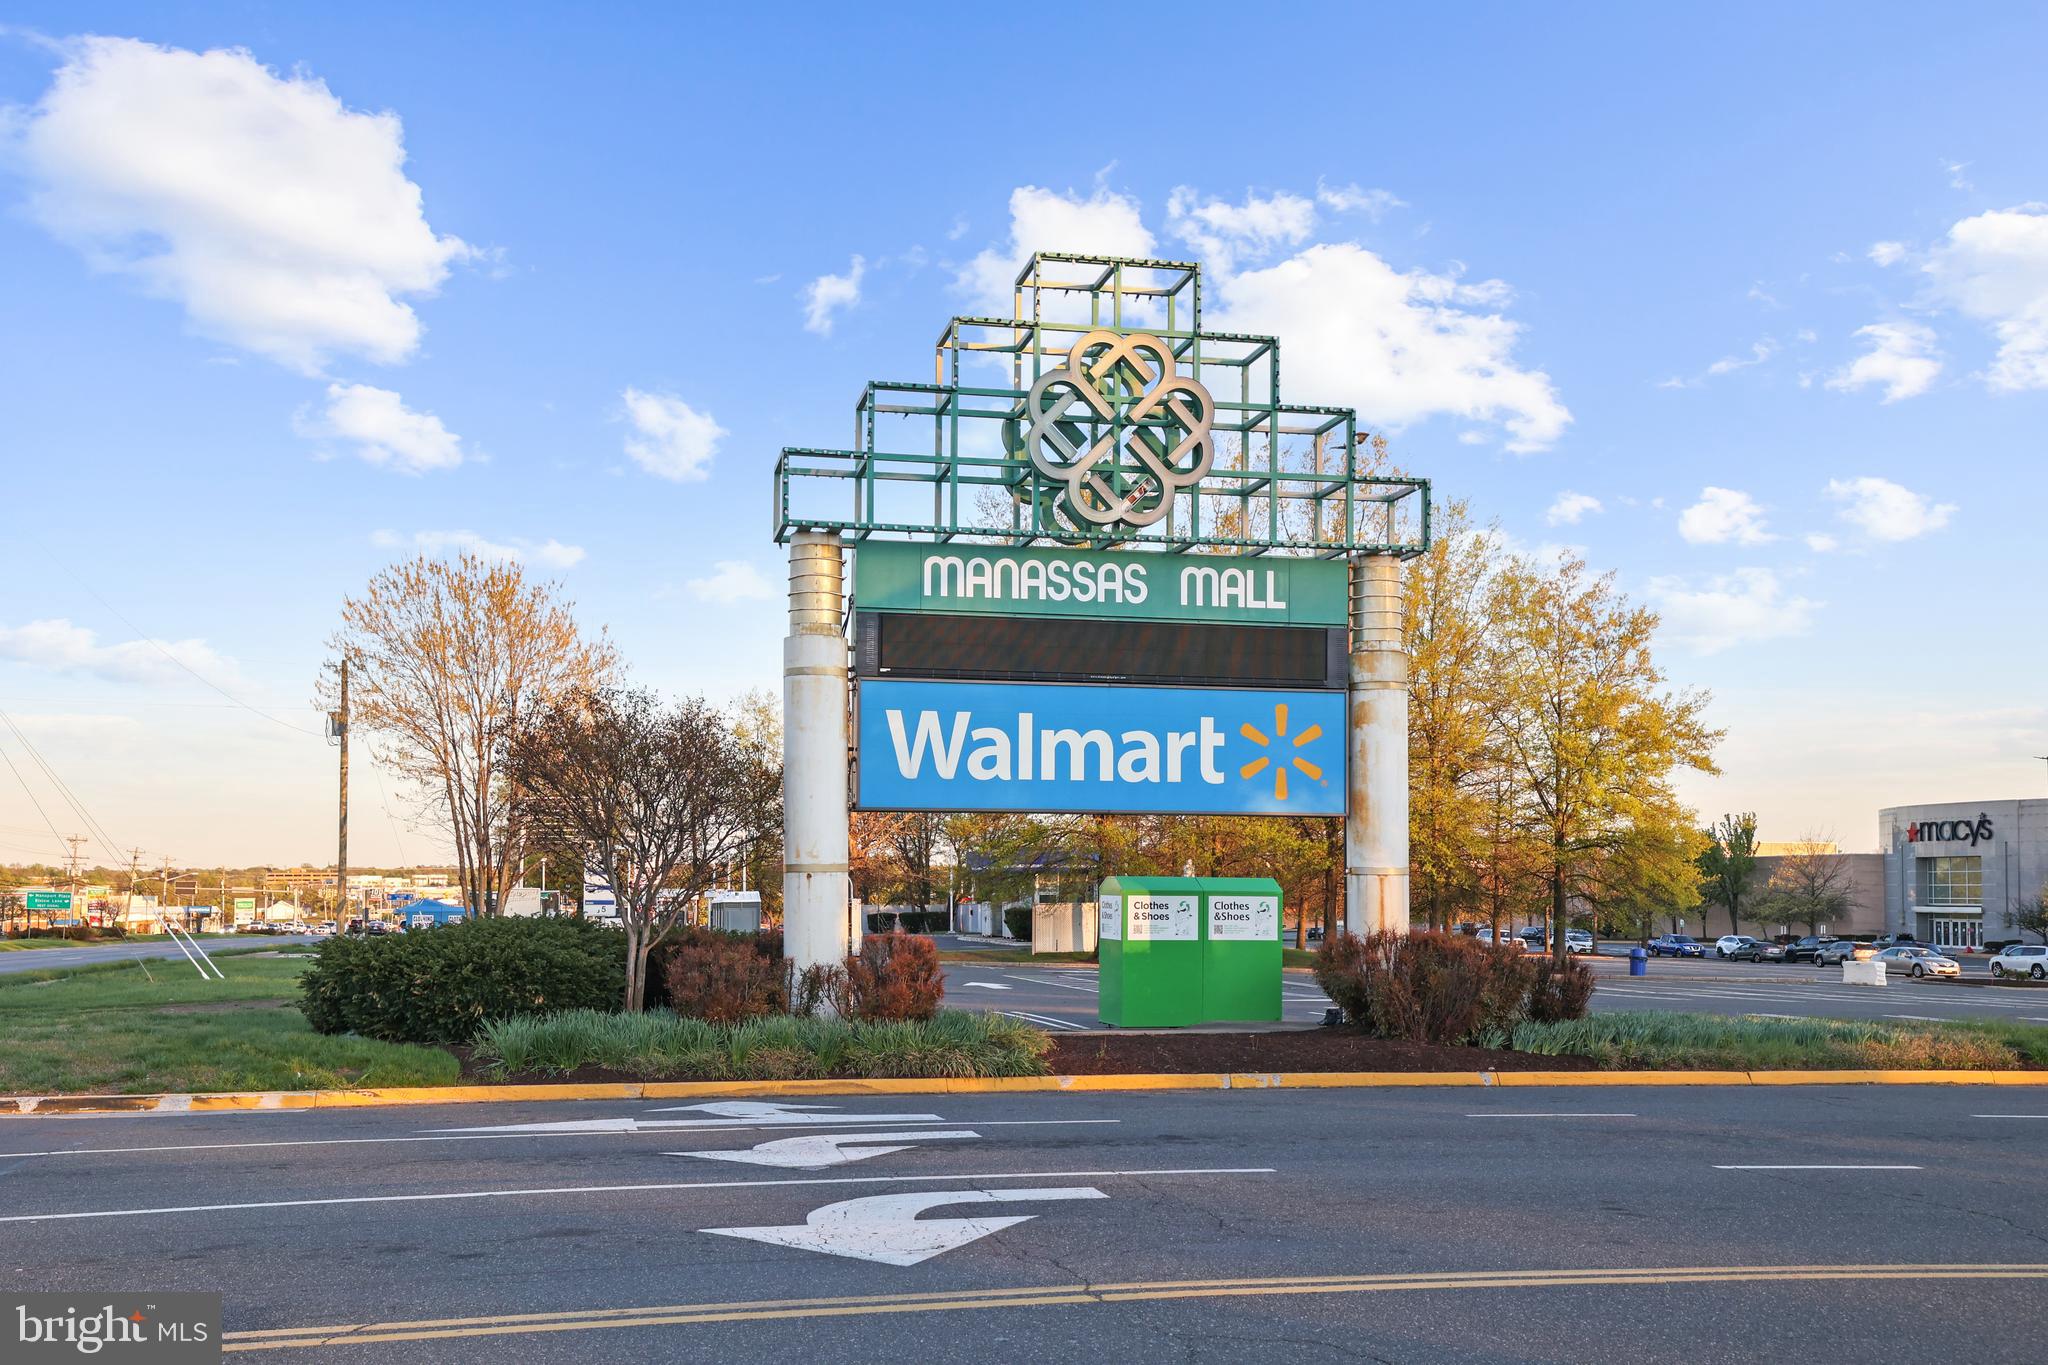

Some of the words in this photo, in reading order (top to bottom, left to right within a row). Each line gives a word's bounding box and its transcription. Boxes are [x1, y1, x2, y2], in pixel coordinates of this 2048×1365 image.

[924, 556, 1148, 604] MANASSAS
[1180, 566, 1286, 609] MALL
[885, 709, 1225, 785] Walmart
[1919, 812, 1994, 847] macy's
[1133, 901, 1169, 910] Clothes
[1133, 912, 1140, 921] &
[1141, 912, 1170, 921] Shoes
[1214, 901, 1250, 911] Clothes
